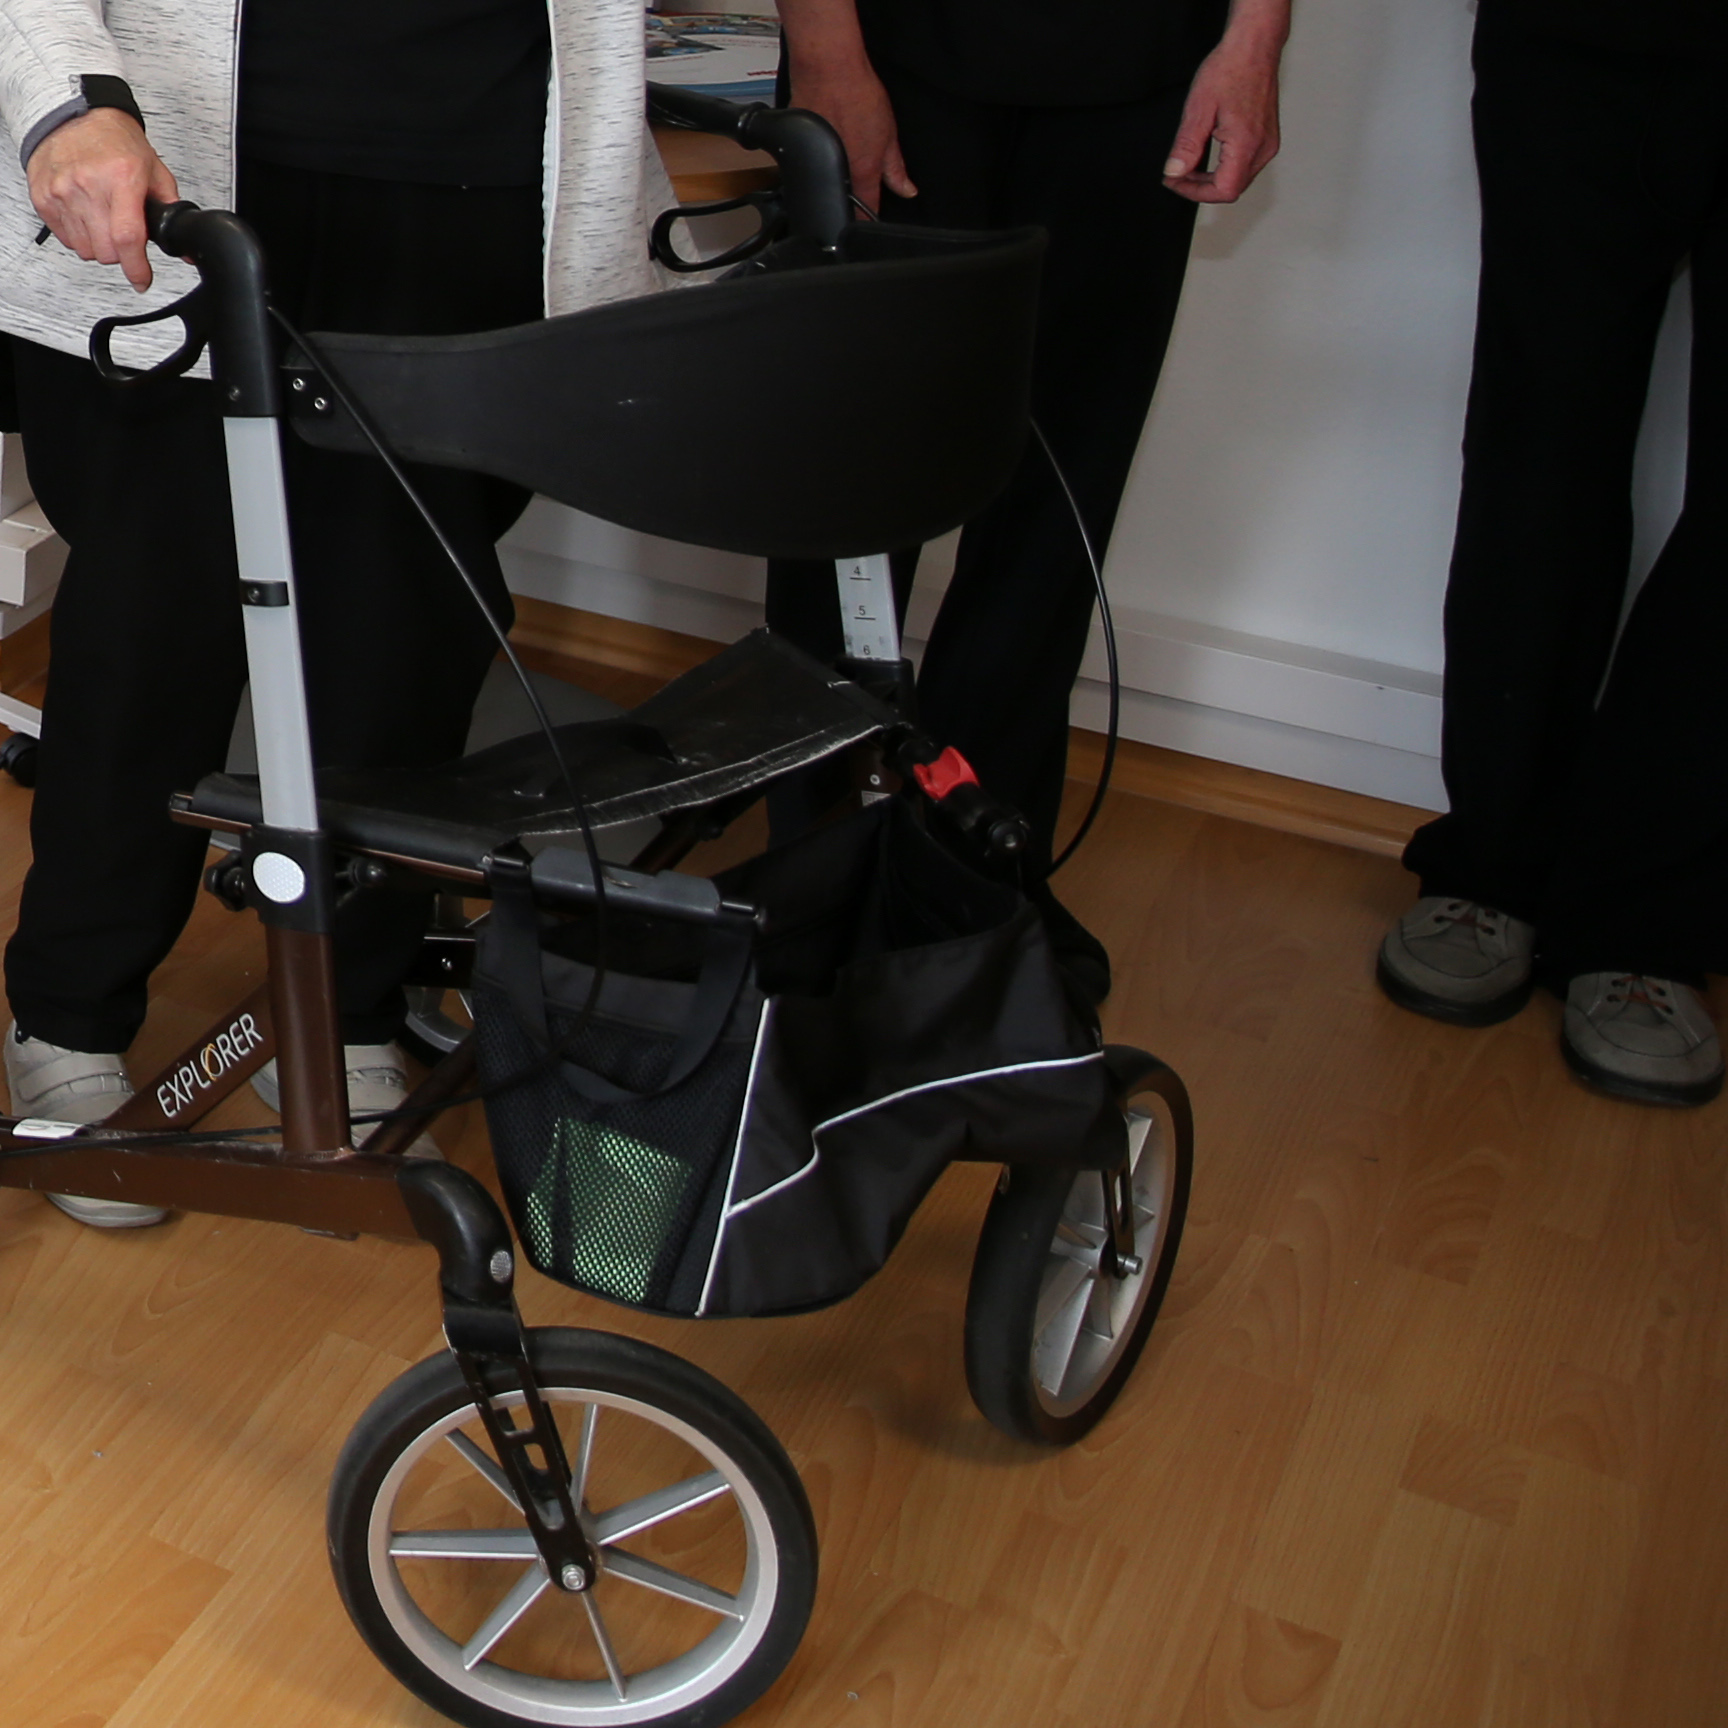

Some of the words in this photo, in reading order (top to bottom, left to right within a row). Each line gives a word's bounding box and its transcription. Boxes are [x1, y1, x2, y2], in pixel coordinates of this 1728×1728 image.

[858, 605, 867, 616] 5
[863, 644, 872, 656] 6
[155, 1012, 265, 1120] EXPLORER
